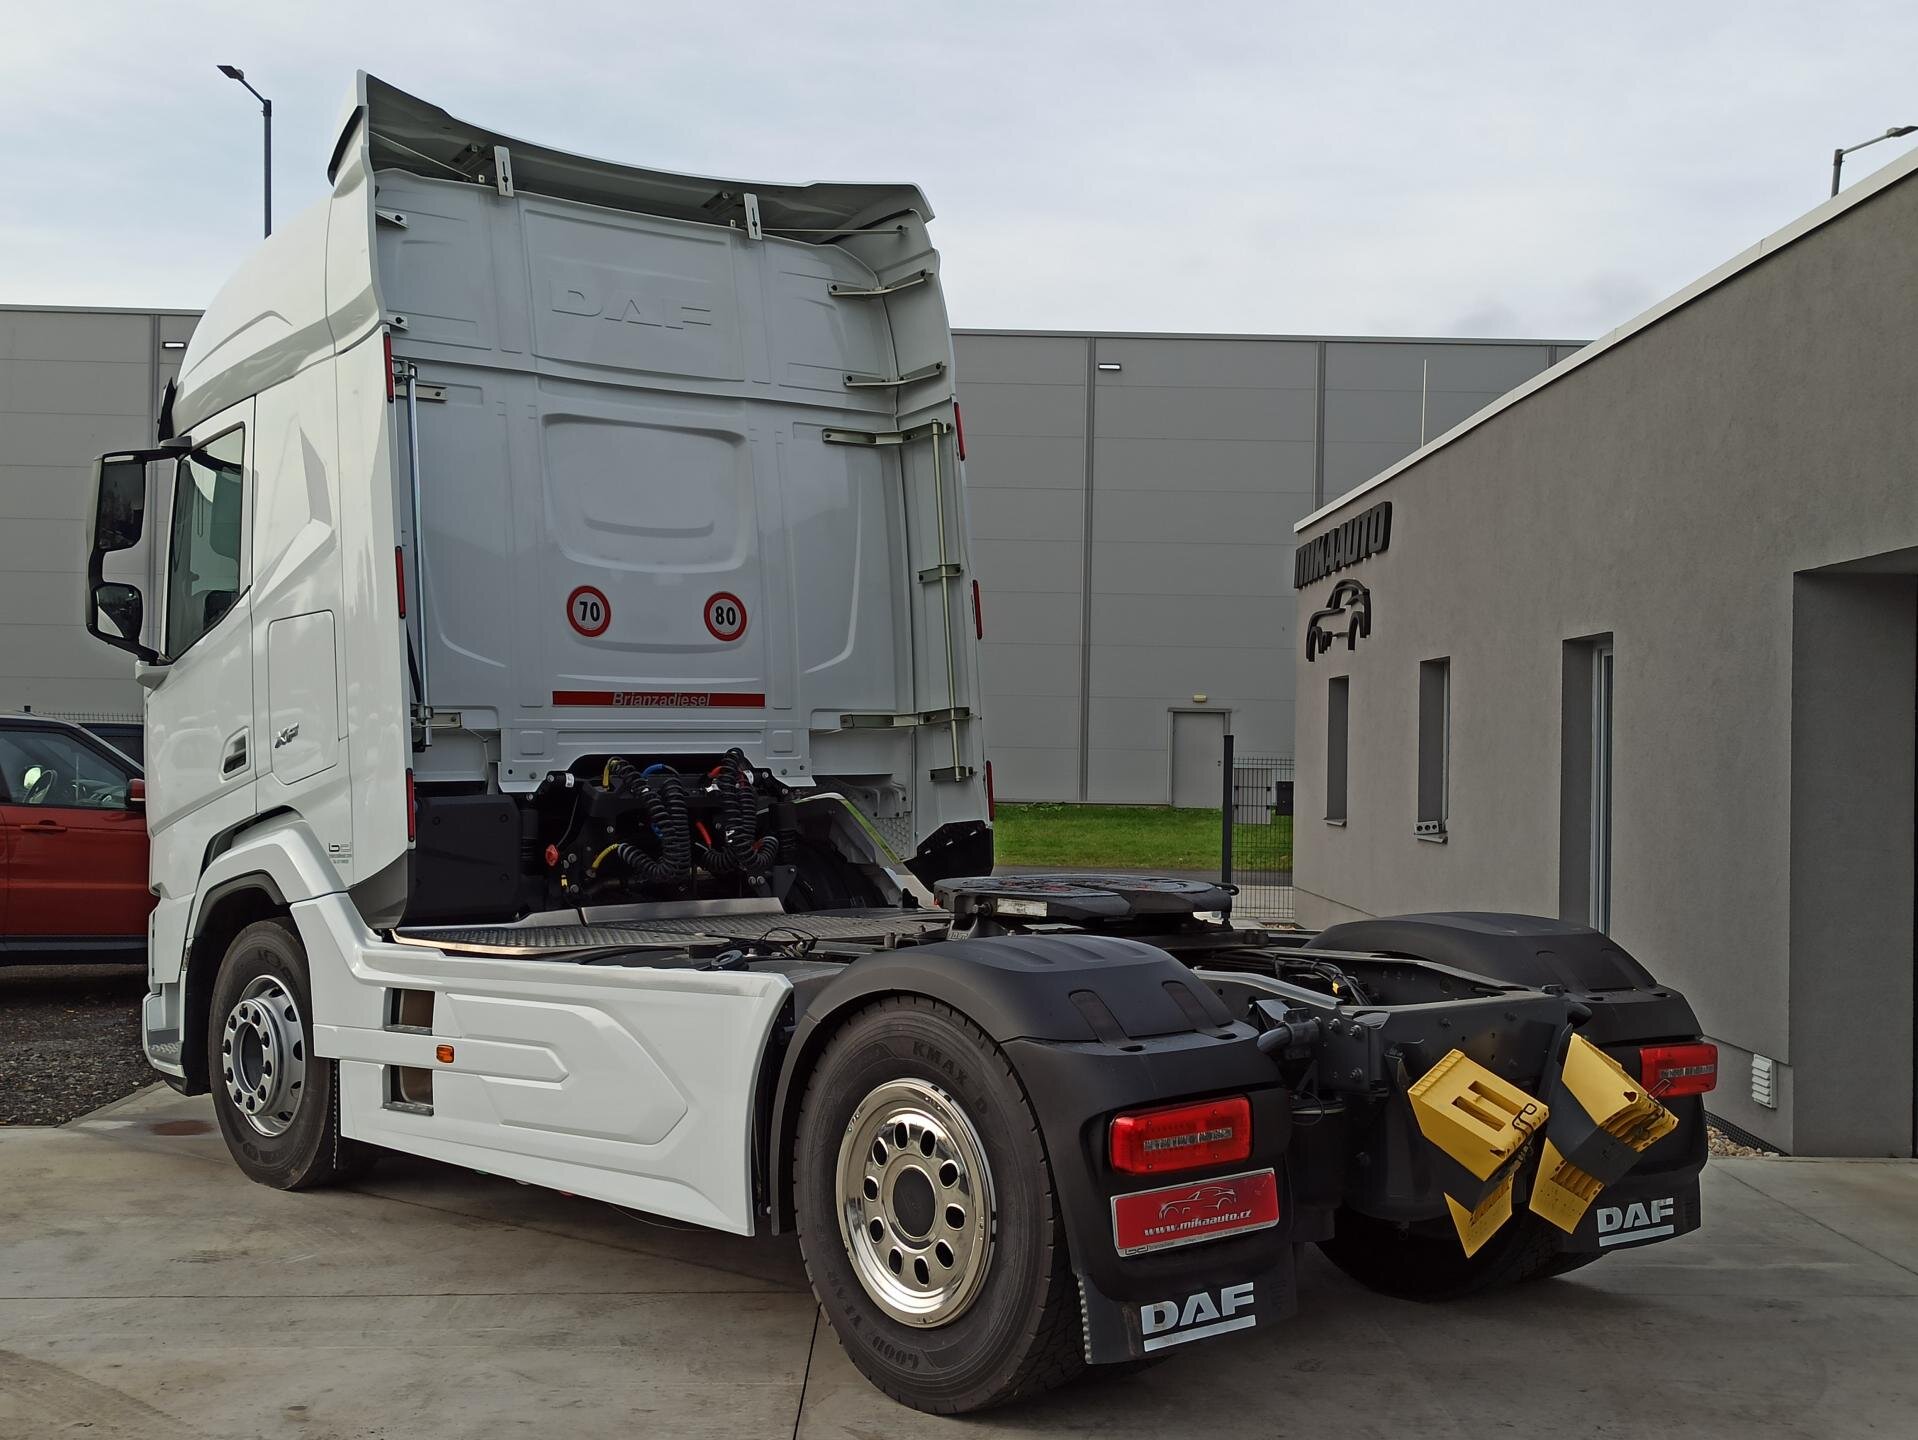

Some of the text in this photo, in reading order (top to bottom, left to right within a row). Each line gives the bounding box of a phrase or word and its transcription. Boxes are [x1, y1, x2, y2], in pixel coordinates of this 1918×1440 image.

[549, 280, 713, 330] DAF
[1294, 501, 1392, 589] MIKAAUTO
[579, 601, 601, 622] 70
[715, 605, 737, 626] 80
[612, 692, 711, 707] Brianzadiesel
[1144, 1209, 1252, 1236] www.mikaauto.cz
[1596, 1197, 1674, 1233] DAF
[1140, 1281, 1255, 1335] DAF
